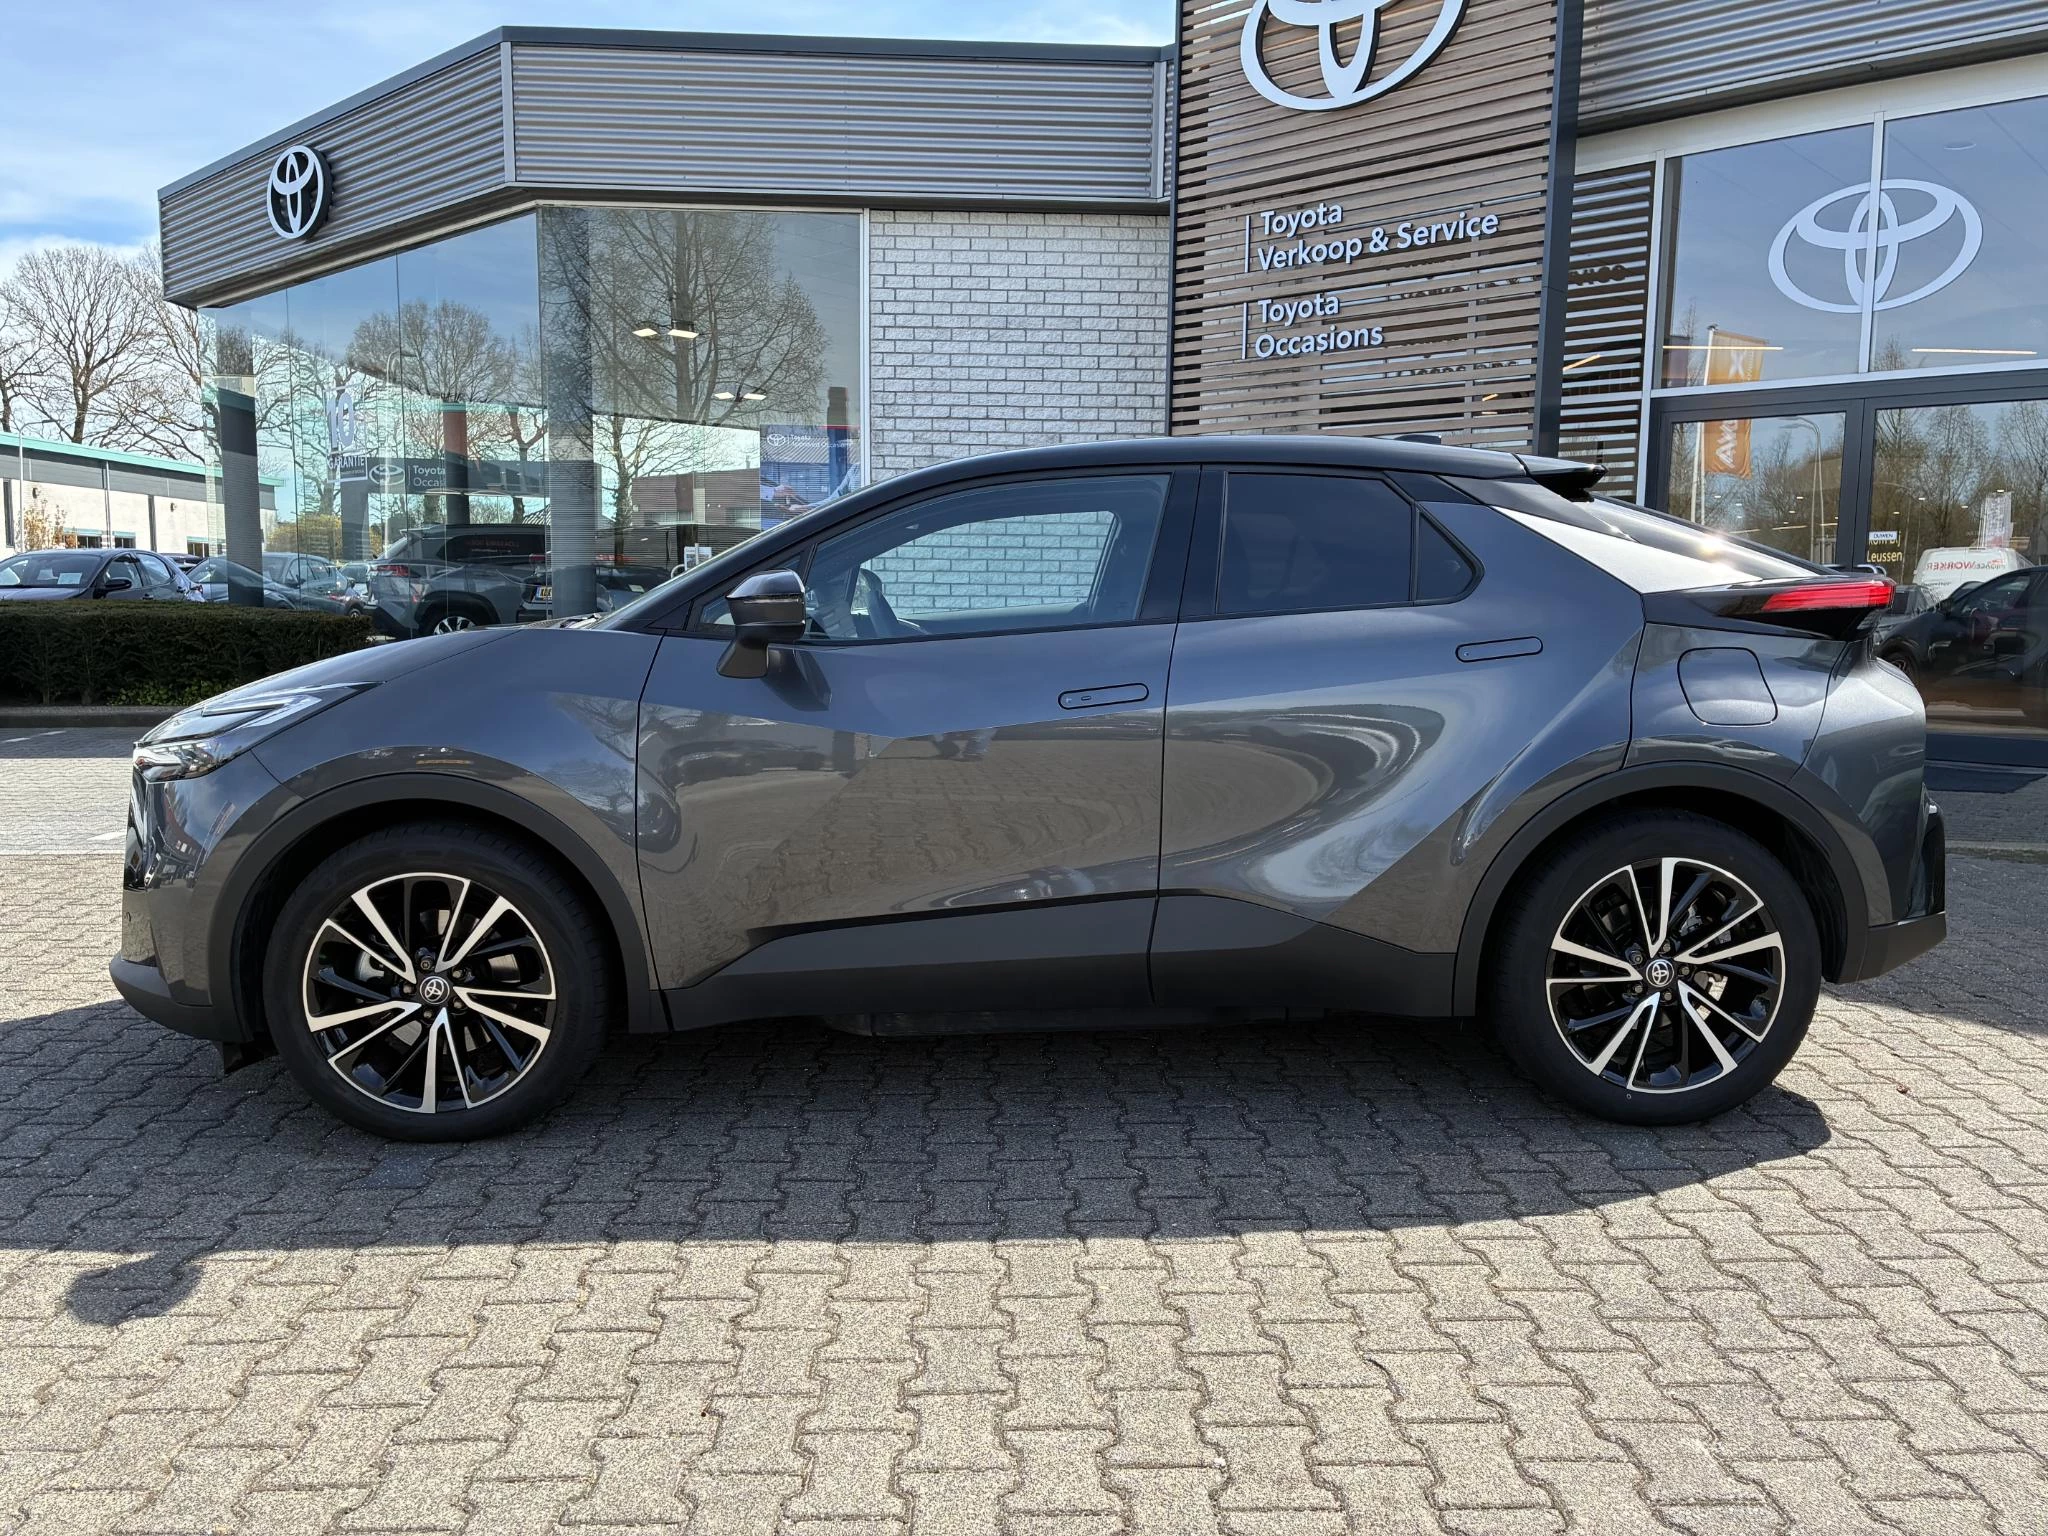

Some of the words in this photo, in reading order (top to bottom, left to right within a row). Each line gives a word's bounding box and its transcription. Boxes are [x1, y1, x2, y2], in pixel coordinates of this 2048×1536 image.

[1260, 203, 1343, 239] Toyota
[1257, 235, 1363, 271] Verkoop
[1368, 226, 1389, 253] &
[1397, 211, 1499, 249] Service
[1256, 293, 1340, 327] Toyota
[1255, 324, 1385, 358] Occasions
[327, 455, 365, 470] GARANTIE
[412, 464, 446, 476] Toyota
[1866, 550, 1903, 563] Leussen
